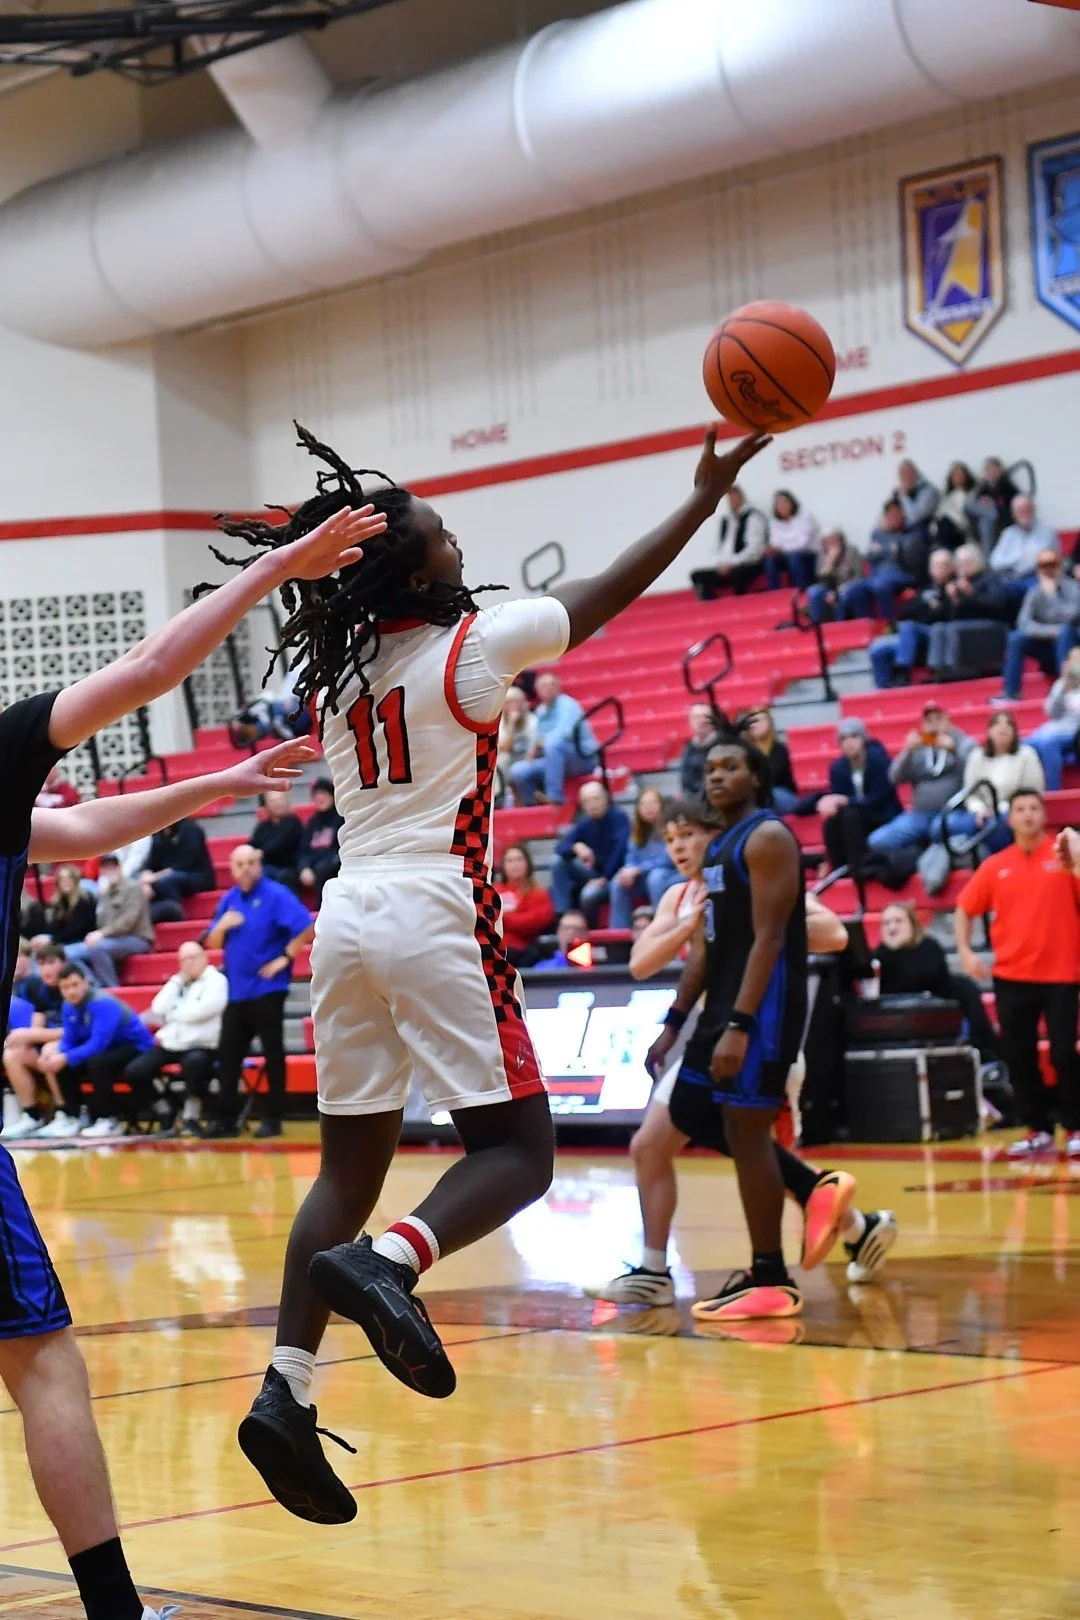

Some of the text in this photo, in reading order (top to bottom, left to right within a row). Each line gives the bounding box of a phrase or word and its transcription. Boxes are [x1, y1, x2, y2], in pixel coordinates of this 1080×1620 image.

[836, 346, 870, 372] ME
[450, 423, 509, 453] HOME
[779, 431, 906, 472] SECTION 2
[346, 686, 412, 790] 11
